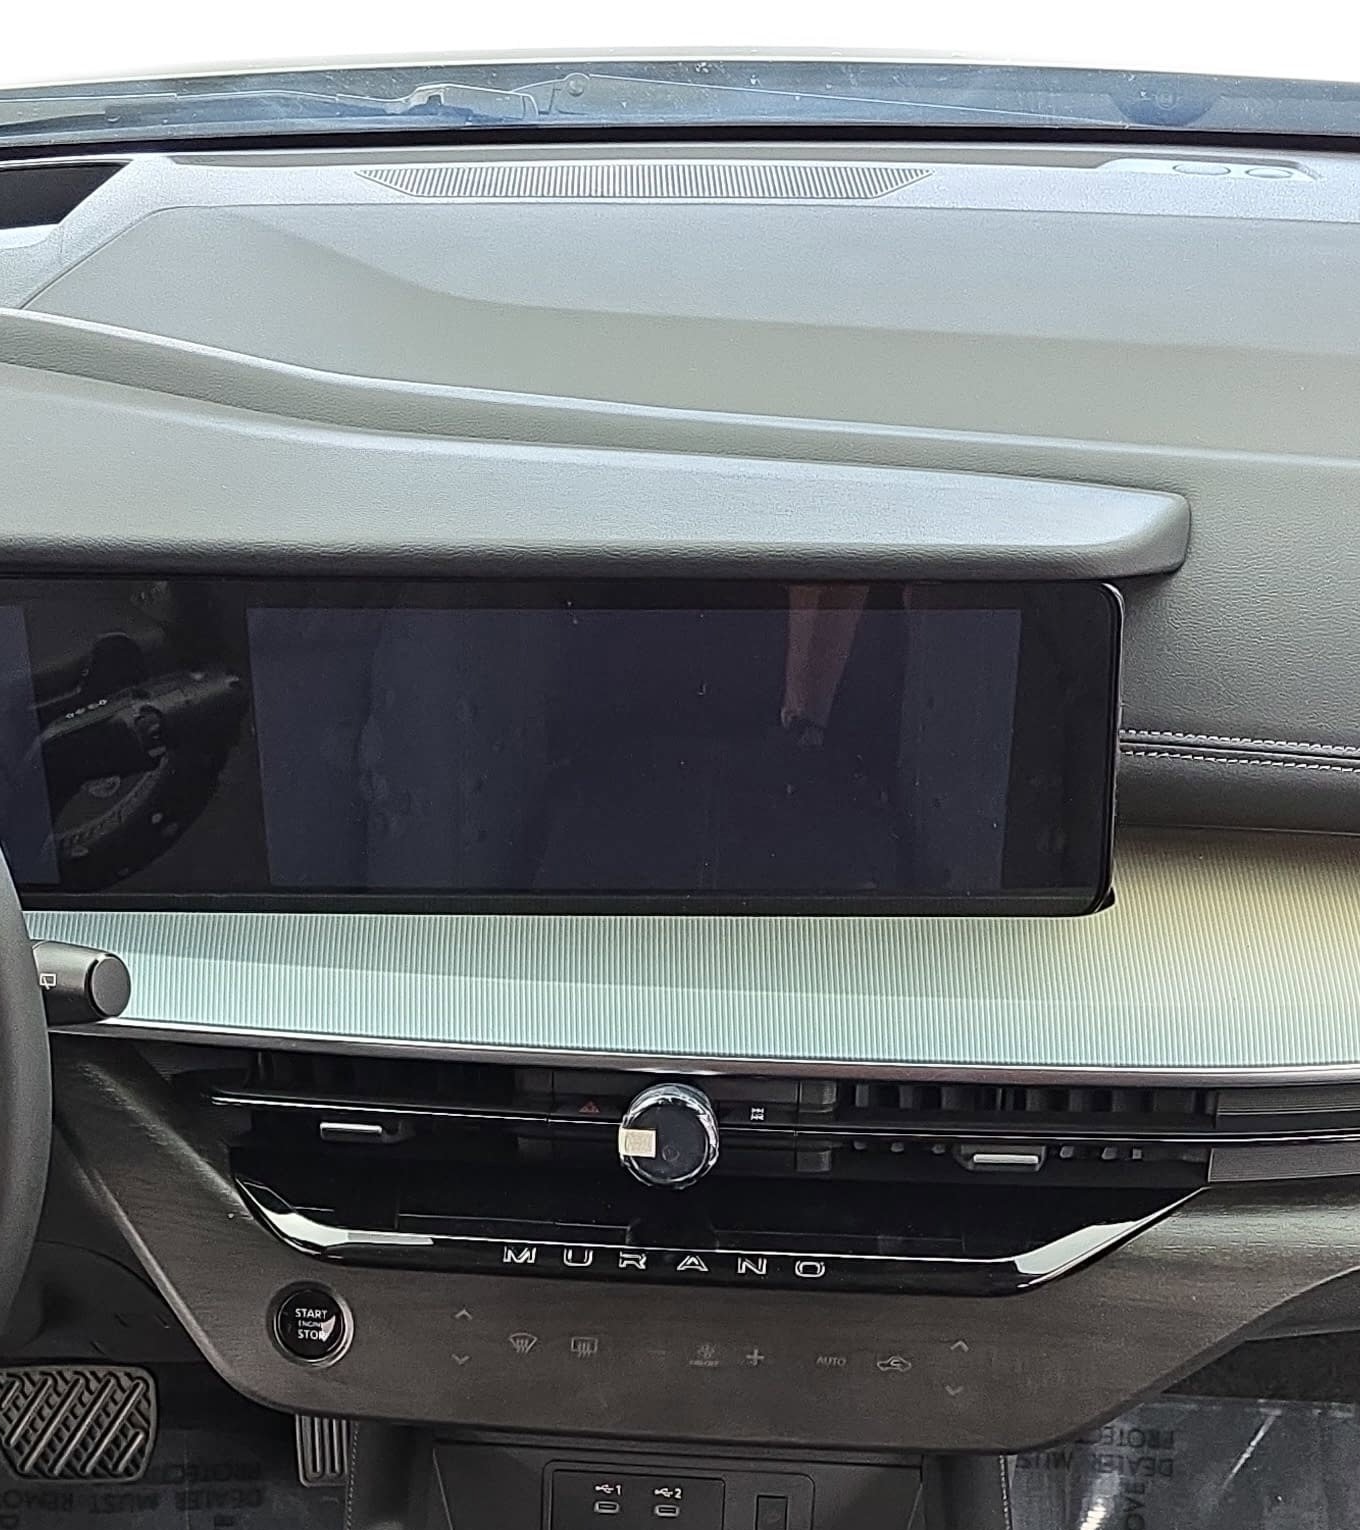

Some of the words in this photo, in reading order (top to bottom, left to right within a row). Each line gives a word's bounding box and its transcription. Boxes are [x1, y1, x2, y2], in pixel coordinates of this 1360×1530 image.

[502, 1244, 826, 1278] MURANO
[295, 1307, 328, 1320] START
[815, 1355, 847, 1369] AUTO
[615, 1484, 622, 1496] 1
[674, 1487, 682, 1500] 2
